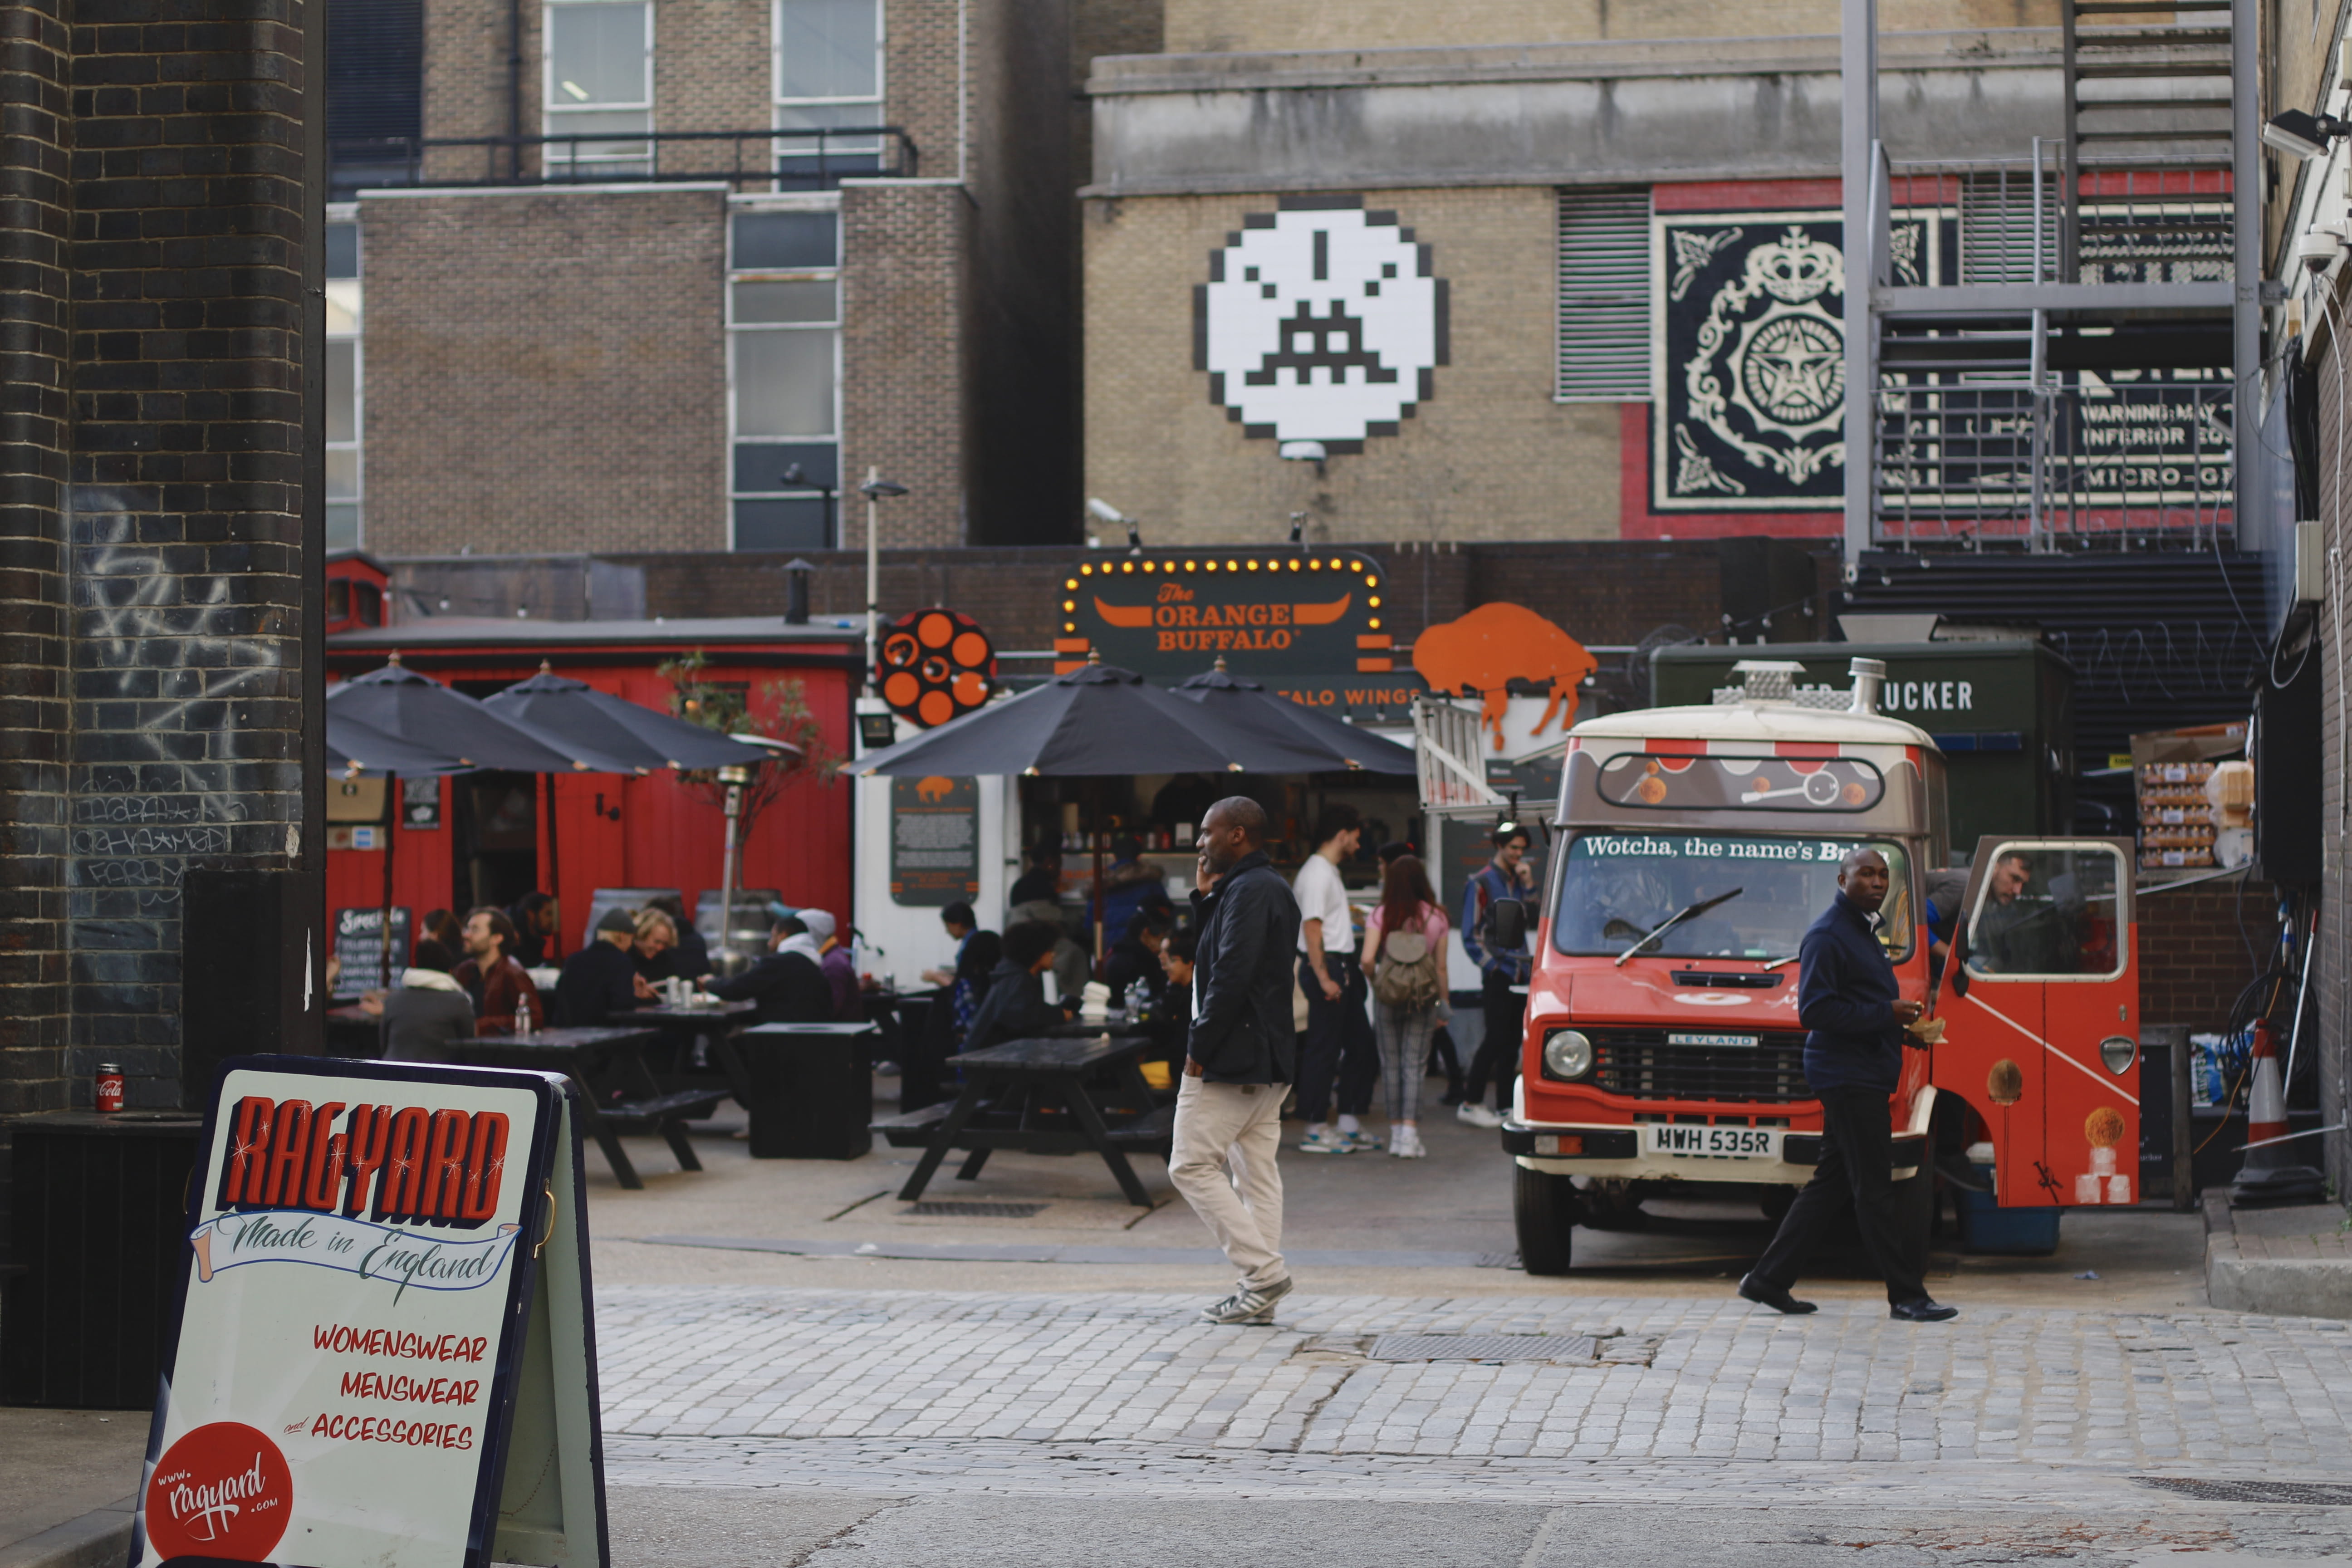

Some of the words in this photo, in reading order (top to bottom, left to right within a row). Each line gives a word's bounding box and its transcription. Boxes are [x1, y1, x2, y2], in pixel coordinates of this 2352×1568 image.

[2082, 427, 2185, 446] INFERIOR
[1157, 583, 1194, 603] The
[1156, 604, 1290, 627] ORANGE
[1157, 629, 1292, 651] BUFFALO
[1877, 681, 1973, 710] UCKER
[1584, 837, 1677, 858] Wotcha,
[1685, 839, 1722, 856] the
[1729, 841, 1813, 861] name's
[1676, 1035, 1752, 1044] LEYLAND
[99, 1080, 122, 1096] Cola
[1657, 1128, 1702, 1150] MWH
[1710, 1131, 1769, 1153] 535R
[216, 1094, 510, 1230] RAGYARD
[216, 1212, 318, 1254] Made
[327, 1230, 354, 1254] in
[359, 1228, 496, 1308] England
[314, 1323, 488, 1363] WOMENSWEAR
[340, 1371, 480, 1406] MENSWEAR
[283, 1416, 309, 1435] and
[311, 1413, 473, 1450] ACCESSORIES
